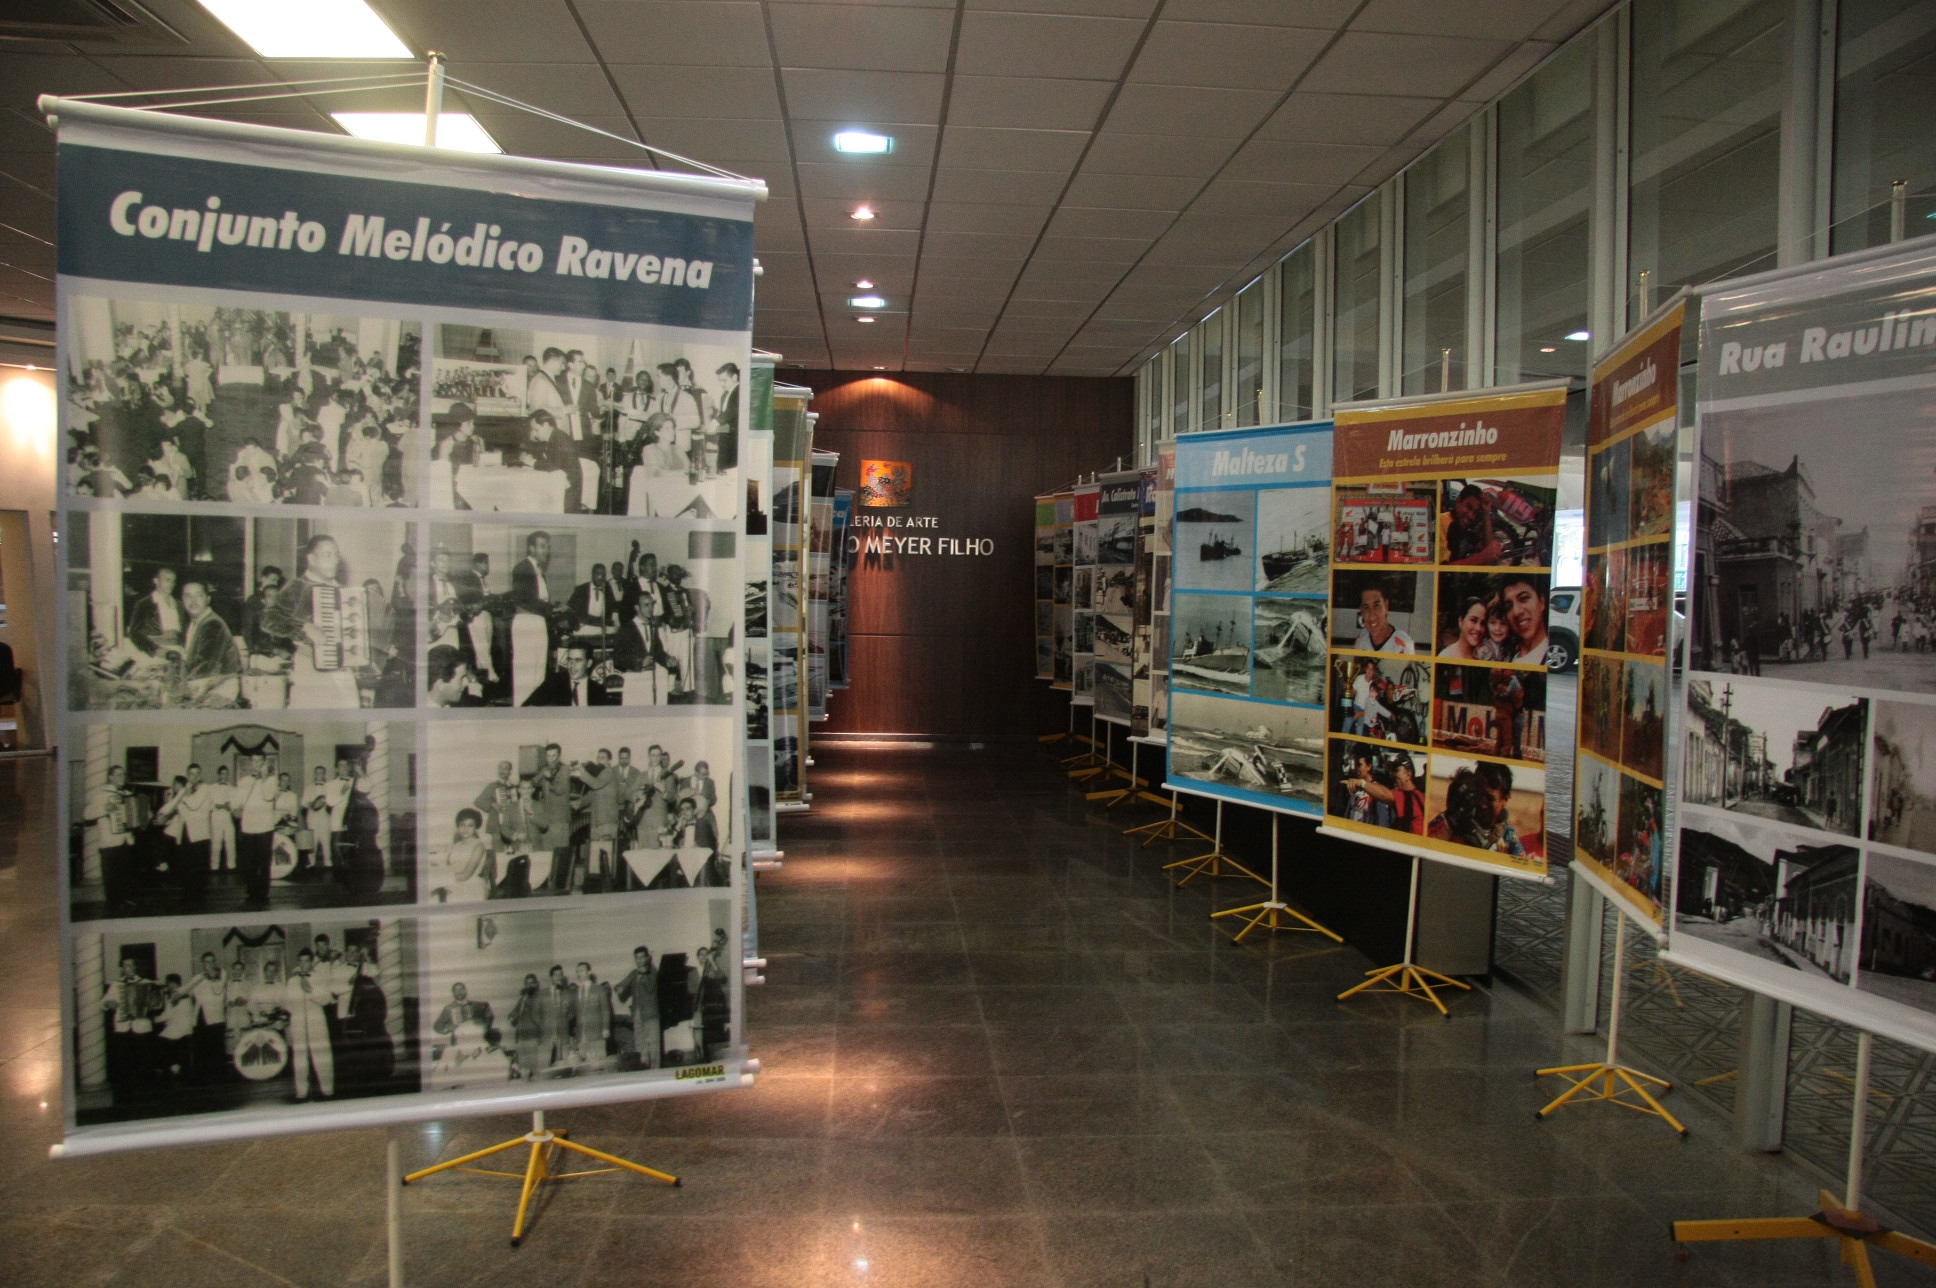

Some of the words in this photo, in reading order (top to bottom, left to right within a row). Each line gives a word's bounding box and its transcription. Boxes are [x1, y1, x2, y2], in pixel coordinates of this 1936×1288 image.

[110, 190, 327, 253] Conjunto
[338, 213, 544, 273] Melódico
[555, 234, 714, 290] Ravena
[1718, 341, 1787, 376] Rua
[1799, 308, 1936, 364] Raulin
[1386, 420, 1498, 452] Marronzinho
[1211, 446, 1289, 477] Malteza
[1292, 443, 1307, 473] S
[1454, 454, 1476, 466] para
[1475, 453, 1508, 464] sempre
[886, 516, 903, 527] DE
[906, 516, 939, 529] ARTE
[864, 535, 932, 555] MEYER
[938, 537, 995, 556] FILHO
[675, 1064, 725, 1080] LAGOMAR
